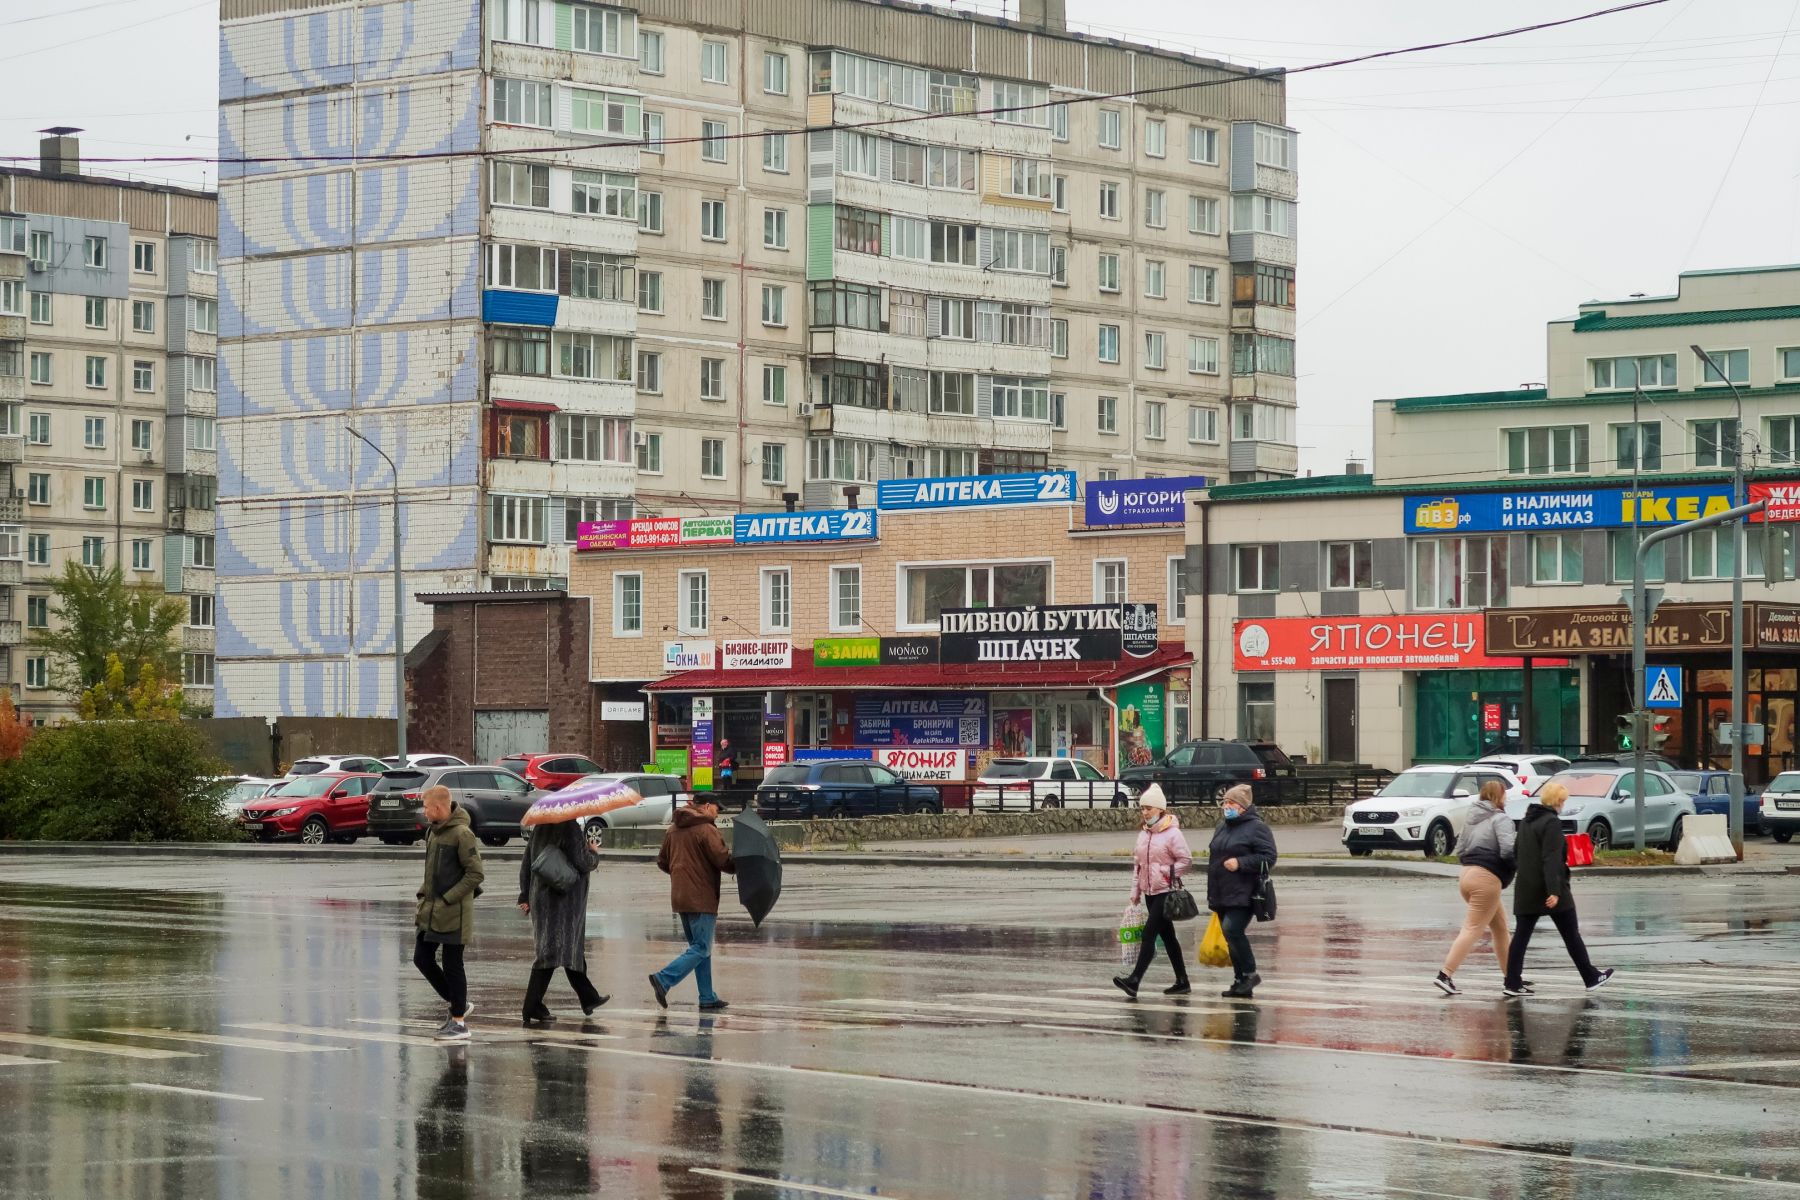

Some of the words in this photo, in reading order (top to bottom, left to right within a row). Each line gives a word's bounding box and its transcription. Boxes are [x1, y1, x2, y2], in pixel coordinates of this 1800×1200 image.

[914, 479, 1003, 502] АПТЕКА
[1038, 474, 1066, 499] 22
[1622, 490, 1654, 498] ТОАРЫ
[1503, 497, 1512, 510] В
[1517, 494, 1593, 510] НАЛИЧИИ
[1622, 496, 1732, 522] IKEA
[683, 519, 732, 527] АВТОШКОЛА
[1419, 509, 1455, 523] ПВЗ
[1503, 514, 1512, 526] И
[1517, 513, 1540, 526] НА
[1542, 511, 1593, 525] ЗАКАЗ
[631, 522, 652, 532] АРЕНДА
[654, 521, 678, 531] ОФИСОВ
[747, 517, 829, 537] АПТЕКА
[841, 511, 867, 536] 22
[683, 527, 732, 537] ПЕРВАЯ
[941, 606, 1039, 633] ПИВНОЙ
[1043, 608, 1121, 631] БУТИК
[1571, 612, 1618, 624] Деловой
[1621, 612, 1659, 624] цер
[1310, 623, 1476, 653] ЯПОНЕЦ
[1782, 628, 1800, 643] ЗЕЛ
[726, 642, 788, 656] БИЗНЕС-ЦЕНТР
[889, 646, 928, 656] MONACO
[977, 638, 1081, 661] ШПАЧЕК
[740, 658, 783, 666] ГЛАДИАТОР
[1271, 657, 1296, 665] 555-400
[1312, 656, 1346, 665] запчасти
[1348, 656, 1363, 665] для
[1366, 655, 1403, 664] японских
[1405, 653, 1459, 664] автомобилей
[882, 701, 938, 713] АПТЕКА
[964, 699, 981, 713] 22
[860, 717, 890, 728] ЗАБИРАЙ
[887, 751, 957, 768] ЯПОНИЯ
[896, 770, 915, 779] УШИ
